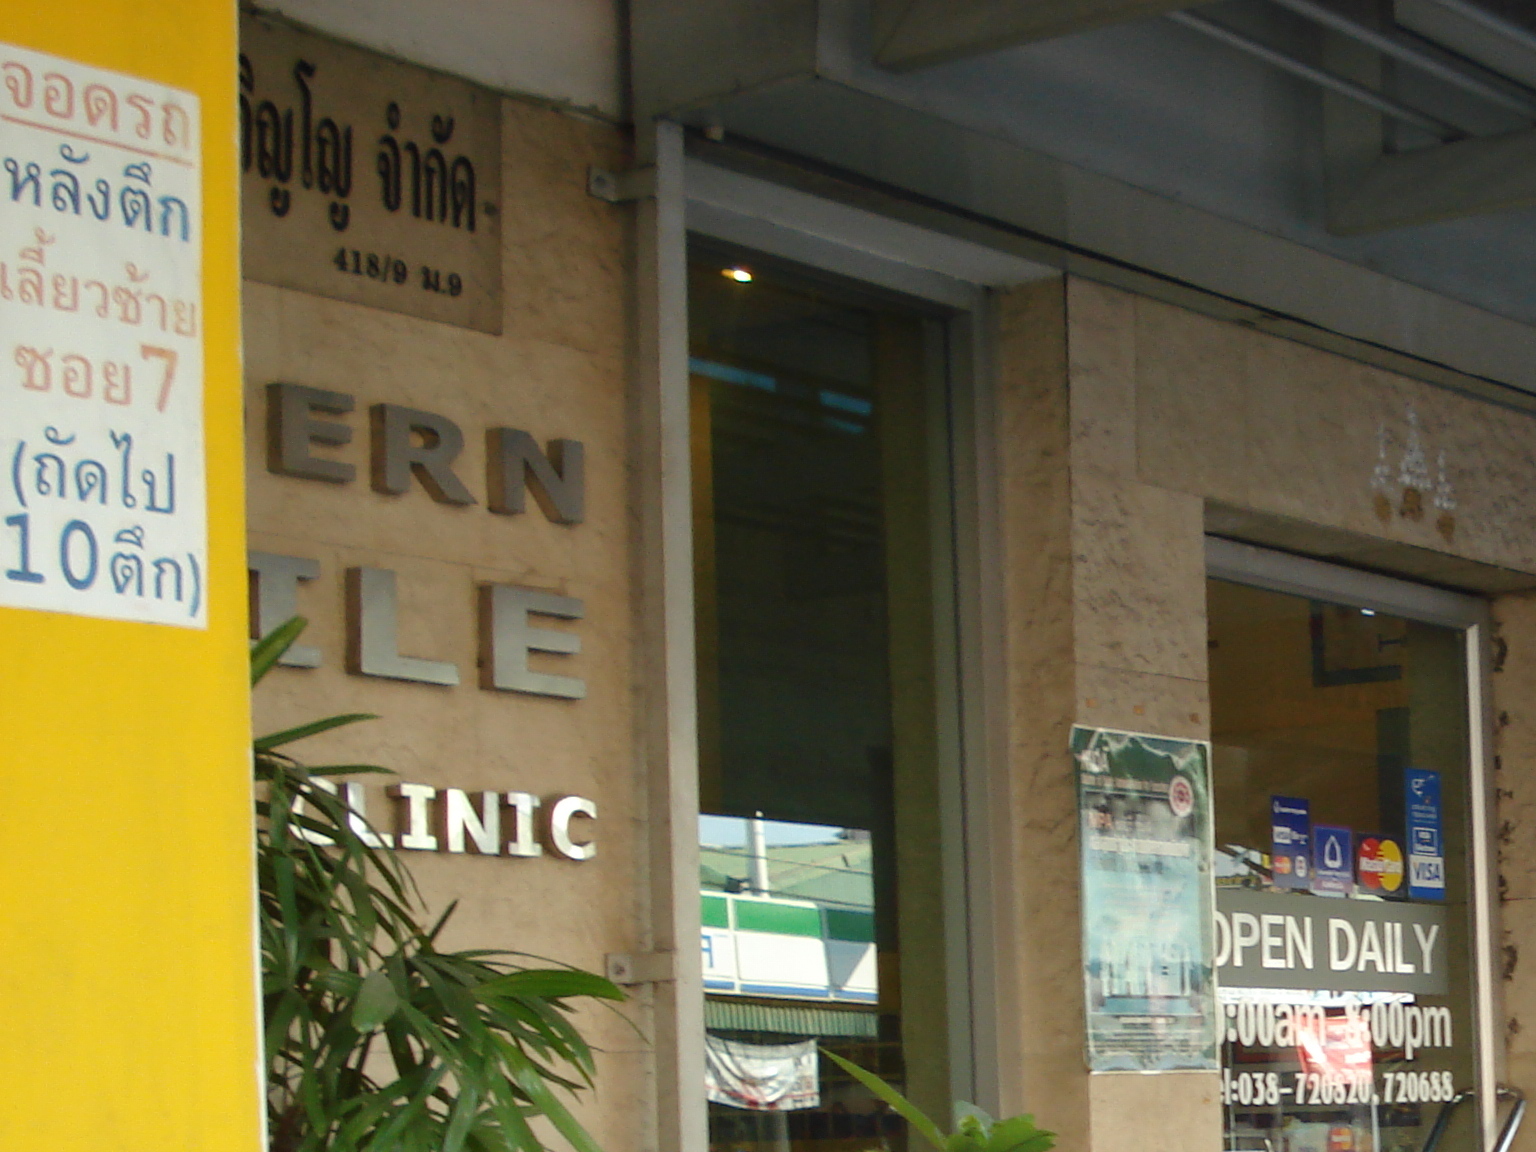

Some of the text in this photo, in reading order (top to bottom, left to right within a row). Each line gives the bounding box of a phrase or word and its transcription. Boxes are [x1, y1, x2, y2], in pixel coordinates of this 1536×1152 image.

[3, 61, 190, 149] จอดรถ
[3, 143, 191, 242] หลังตึก
[376, 102, 476, 232] จำกัด
[0, 226, 198, 338] เลี้ยวซ้าย
[333, 247, 409, 285] 418/9
[12, 425, 175, 515] (ถัดไป
[266, 382, 586, 527] ERN
[1213, 910, 1440, 975] OPEN DAILY
